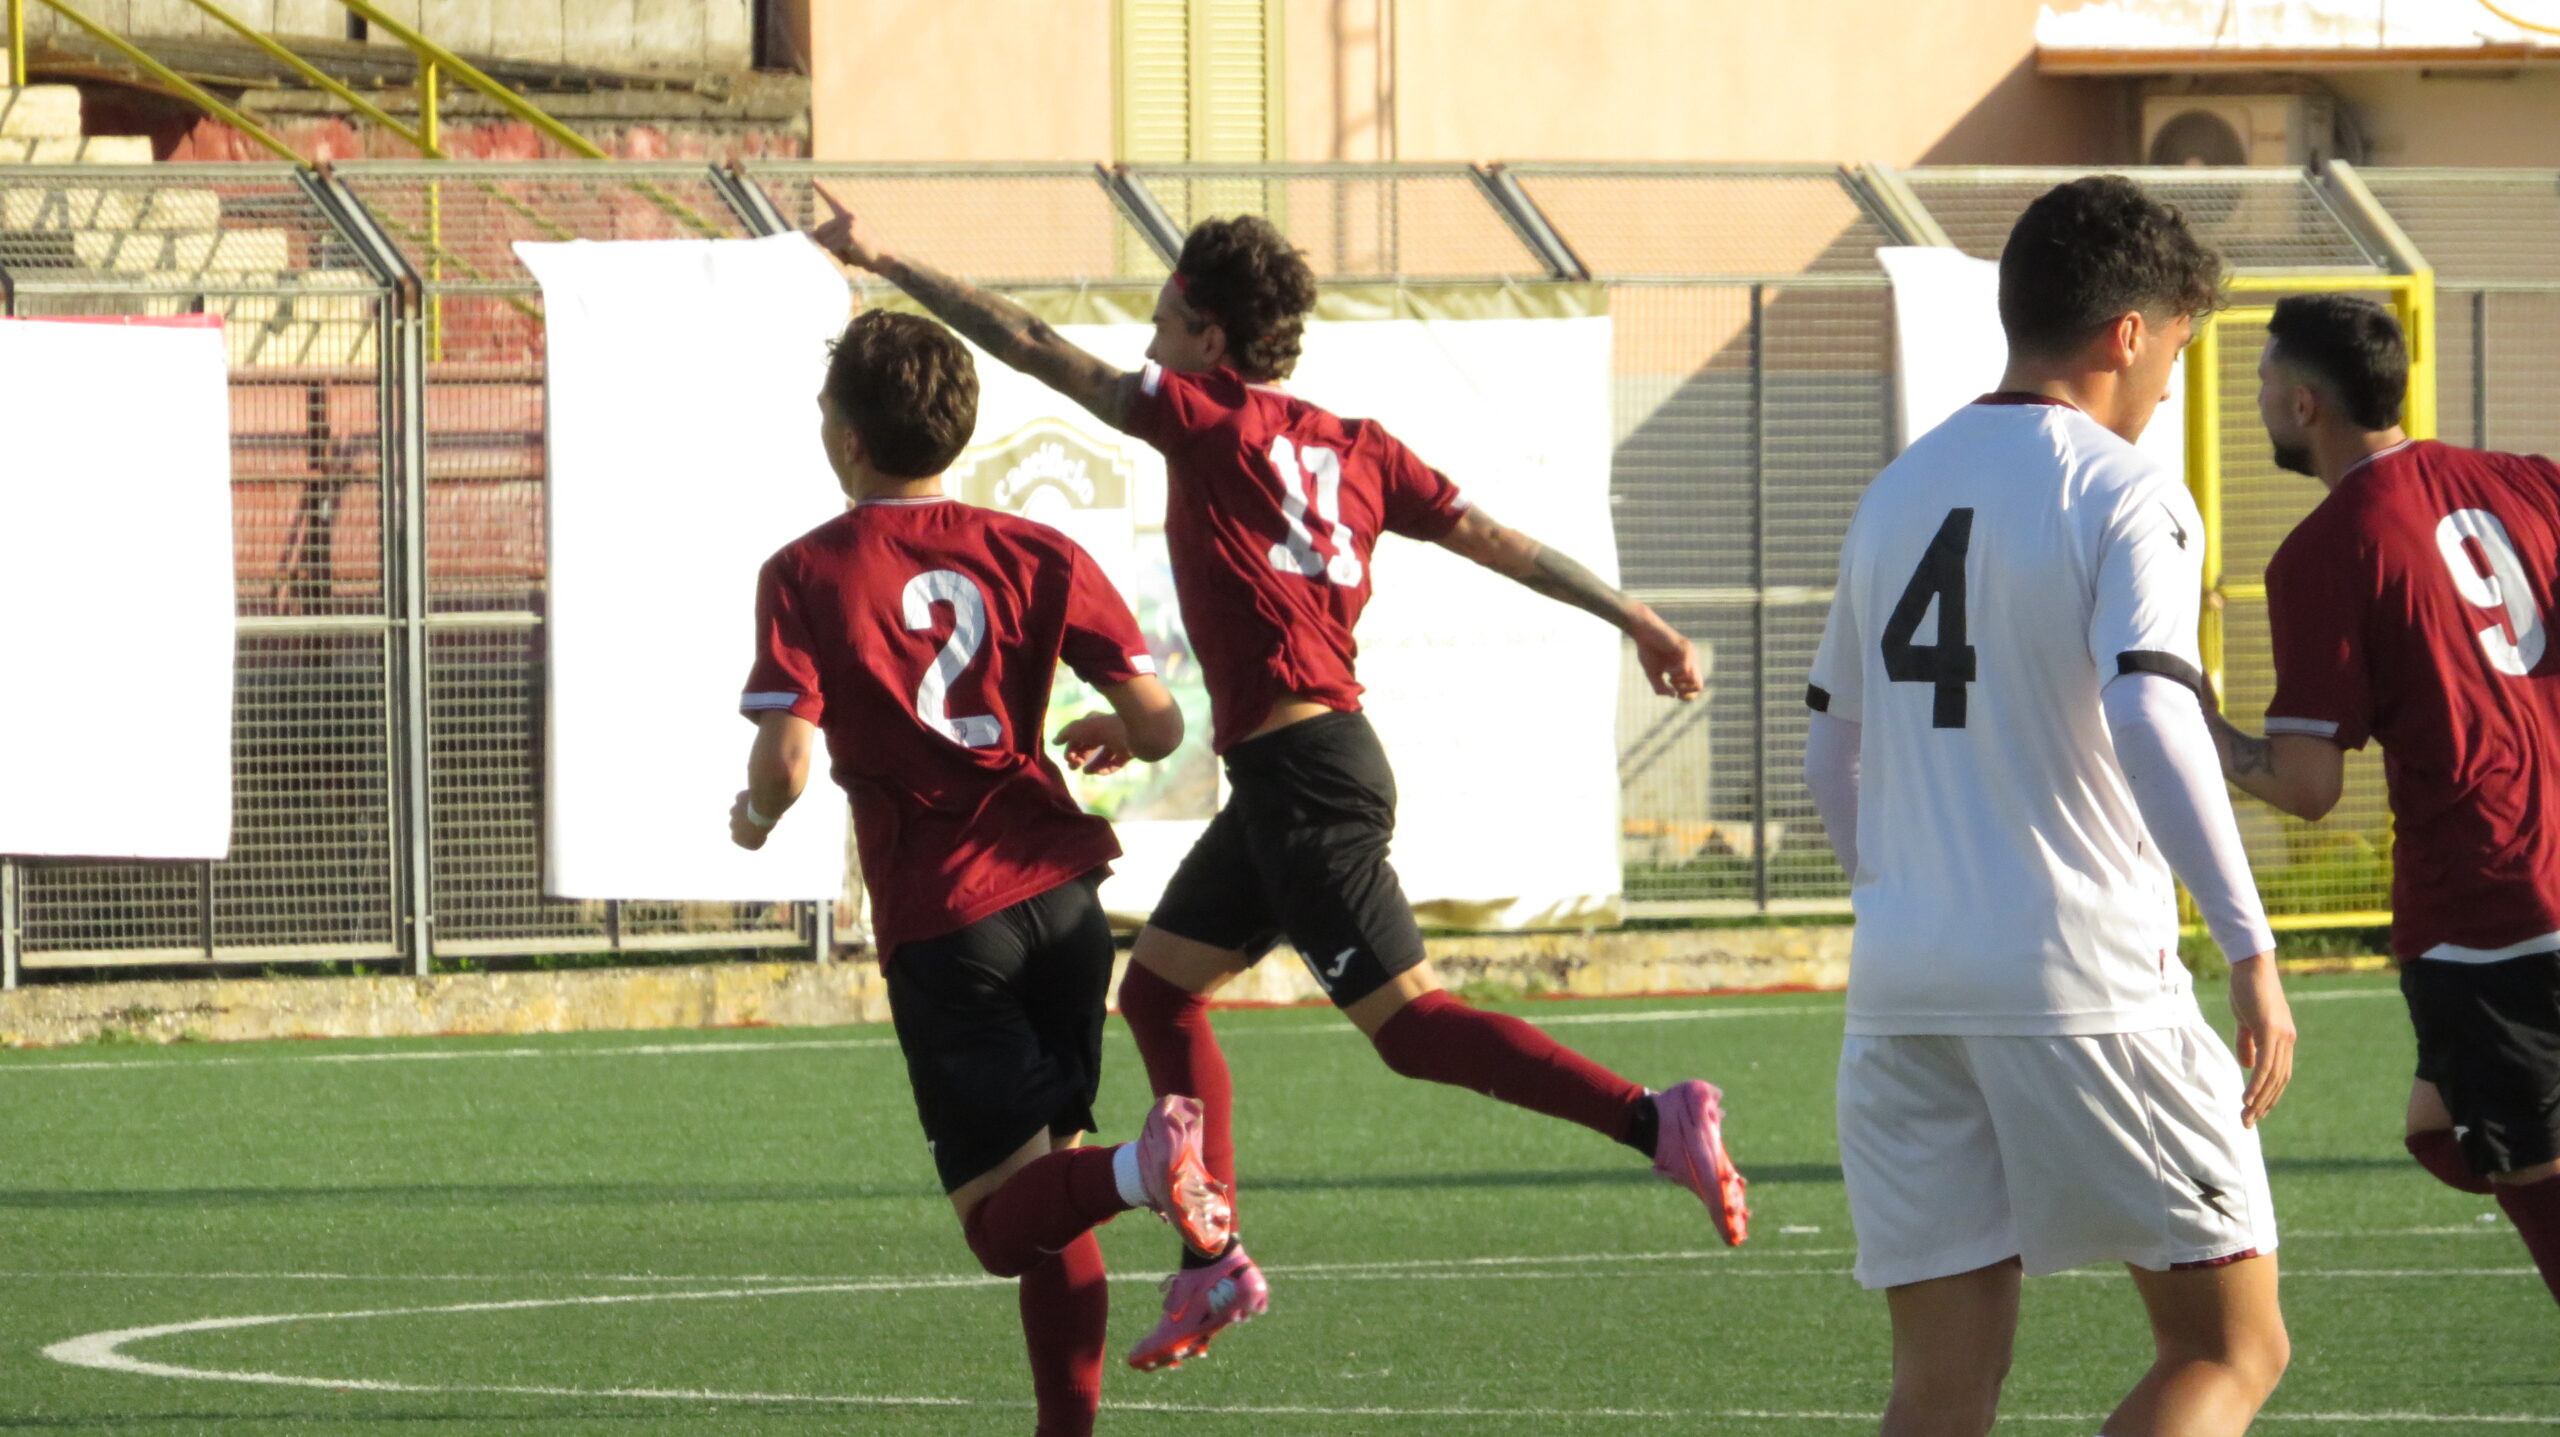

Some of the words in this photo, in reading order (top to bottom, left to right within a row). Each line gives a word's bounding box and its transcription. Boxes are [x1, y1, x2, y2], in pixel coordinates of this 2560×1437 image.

[901, 569, 1002, 748] 2
[1881, 507, 1976, 728] 4
[2436, 508, 2545, 676] 9
